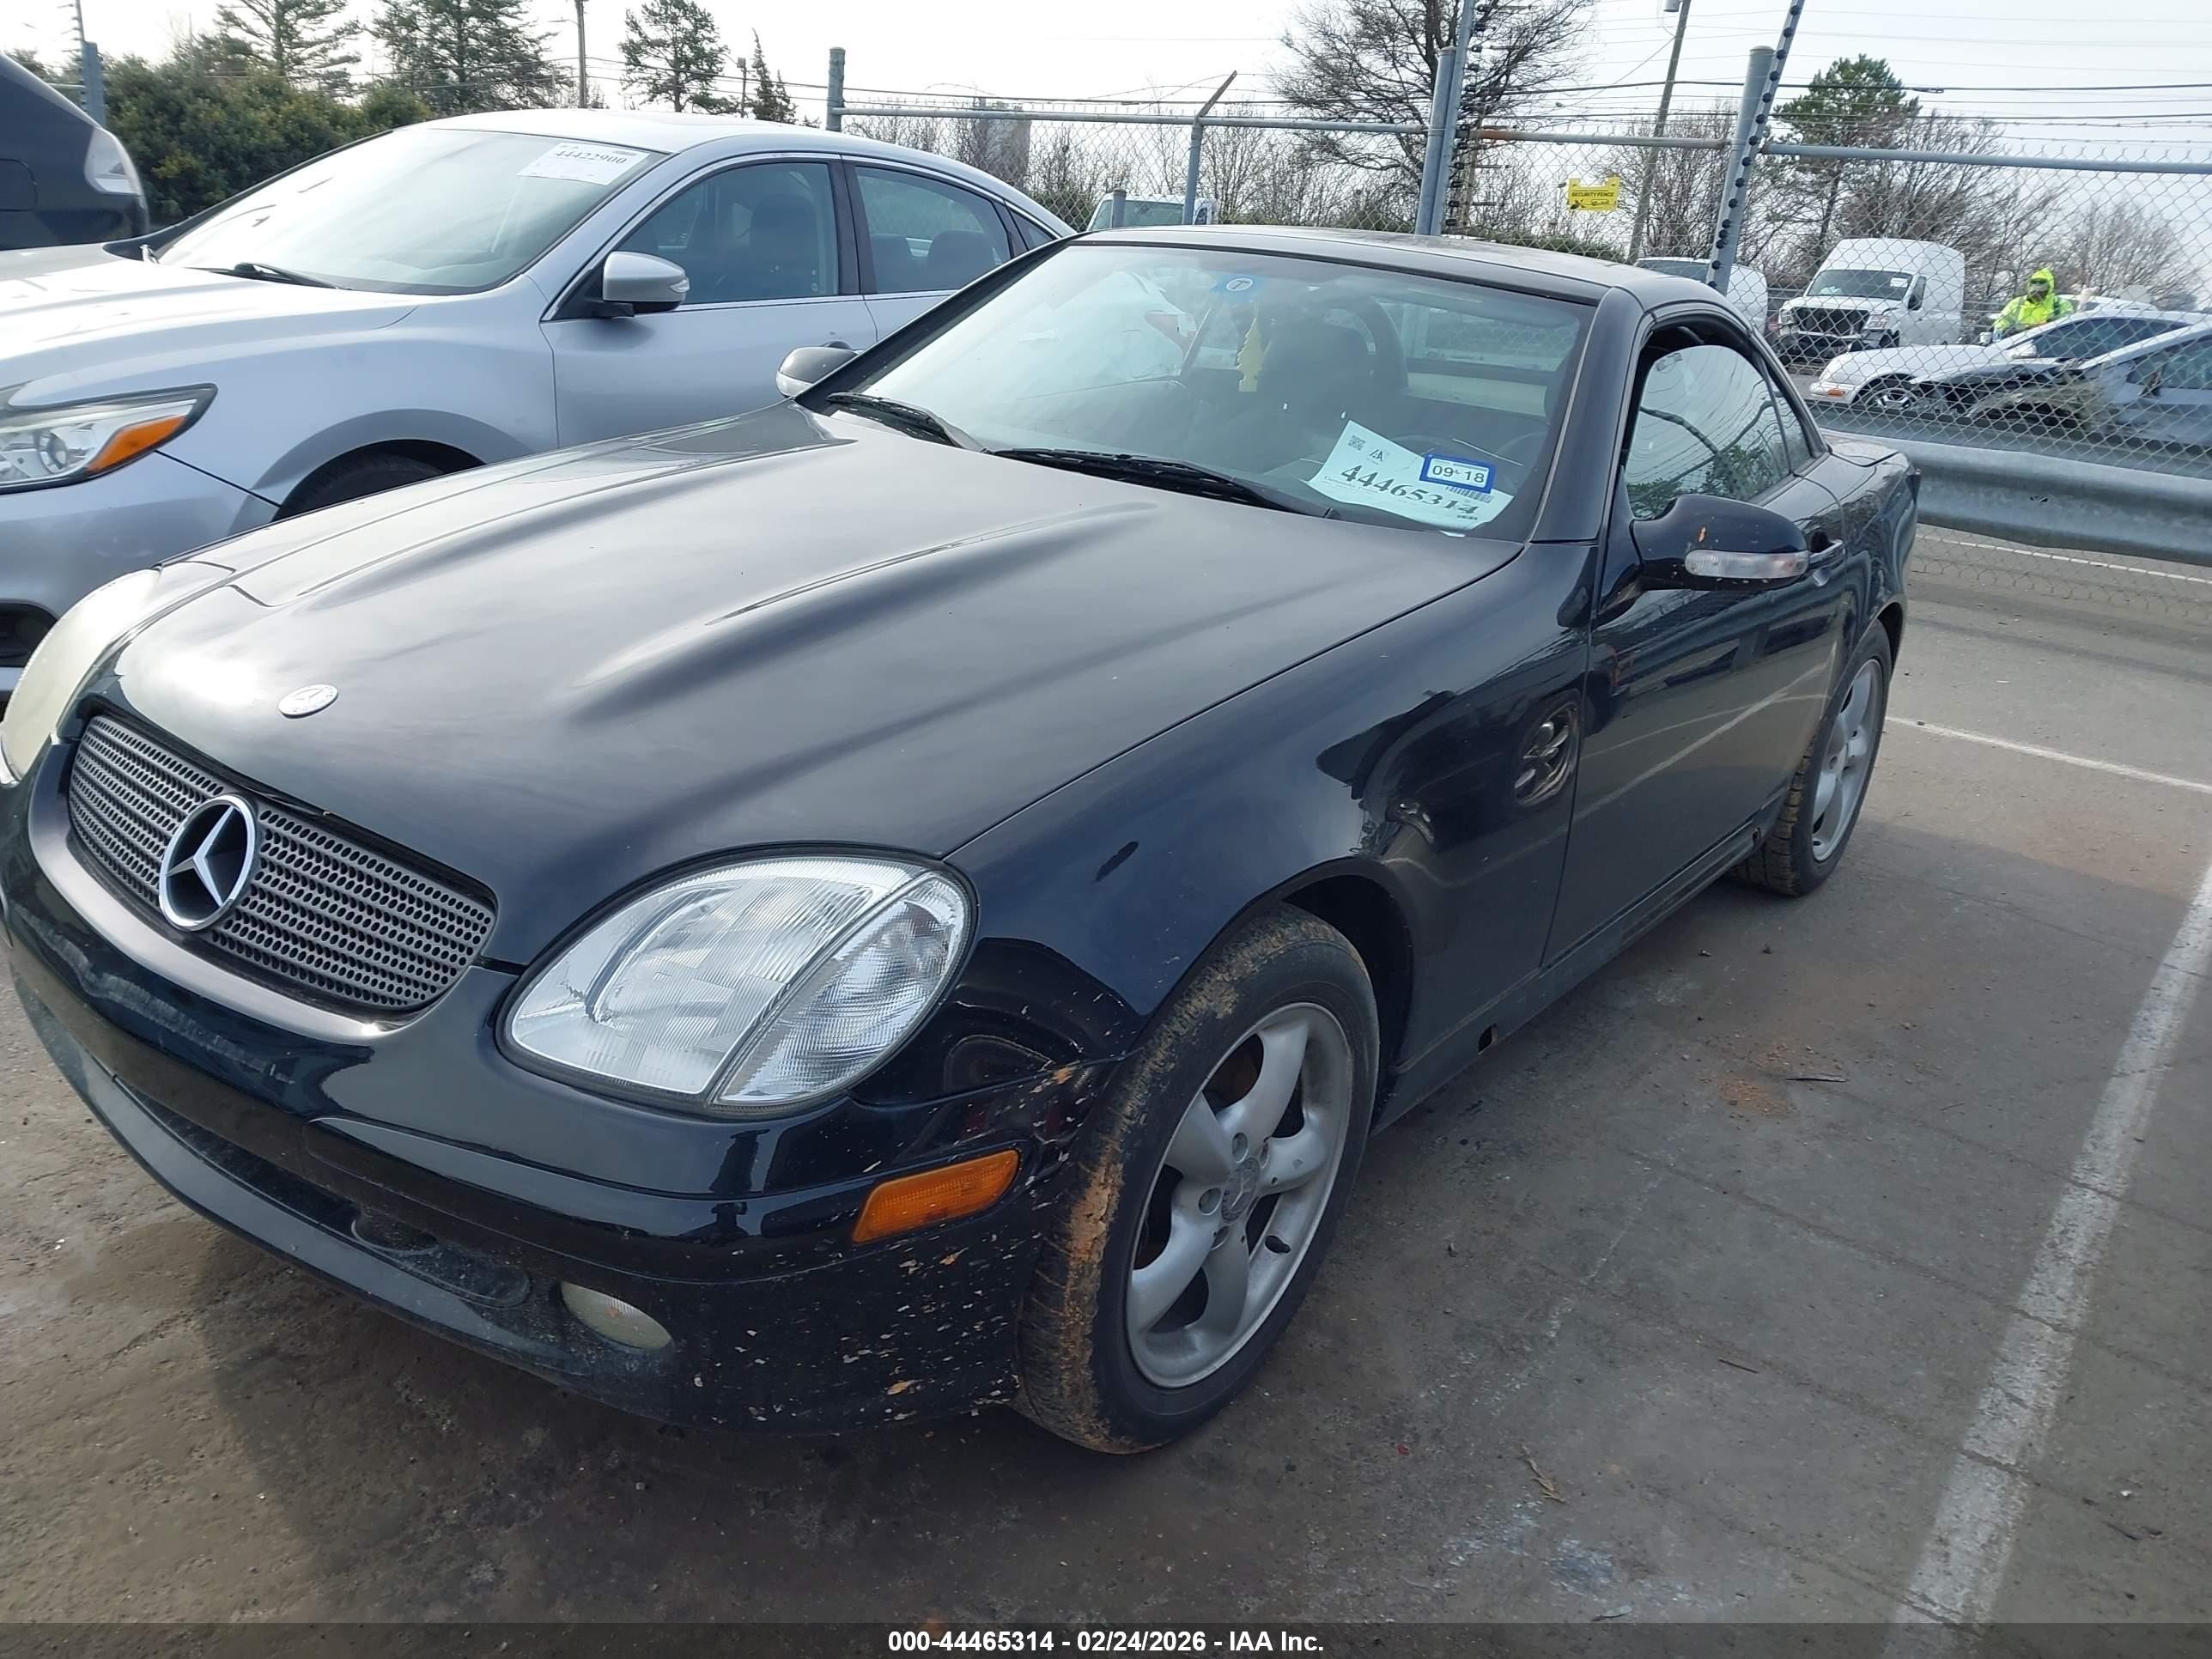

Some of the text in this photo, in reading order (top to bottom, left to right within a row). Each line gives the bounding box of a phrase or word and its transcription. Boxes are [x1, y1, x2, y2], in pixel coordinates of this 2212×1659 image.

[555, 150, 628, 164] 44422900
[1432, 465, 1454, 477] 09
[1464, 471, 1485, 483] 18
[1340, 465, 1480, 514] 44465314
